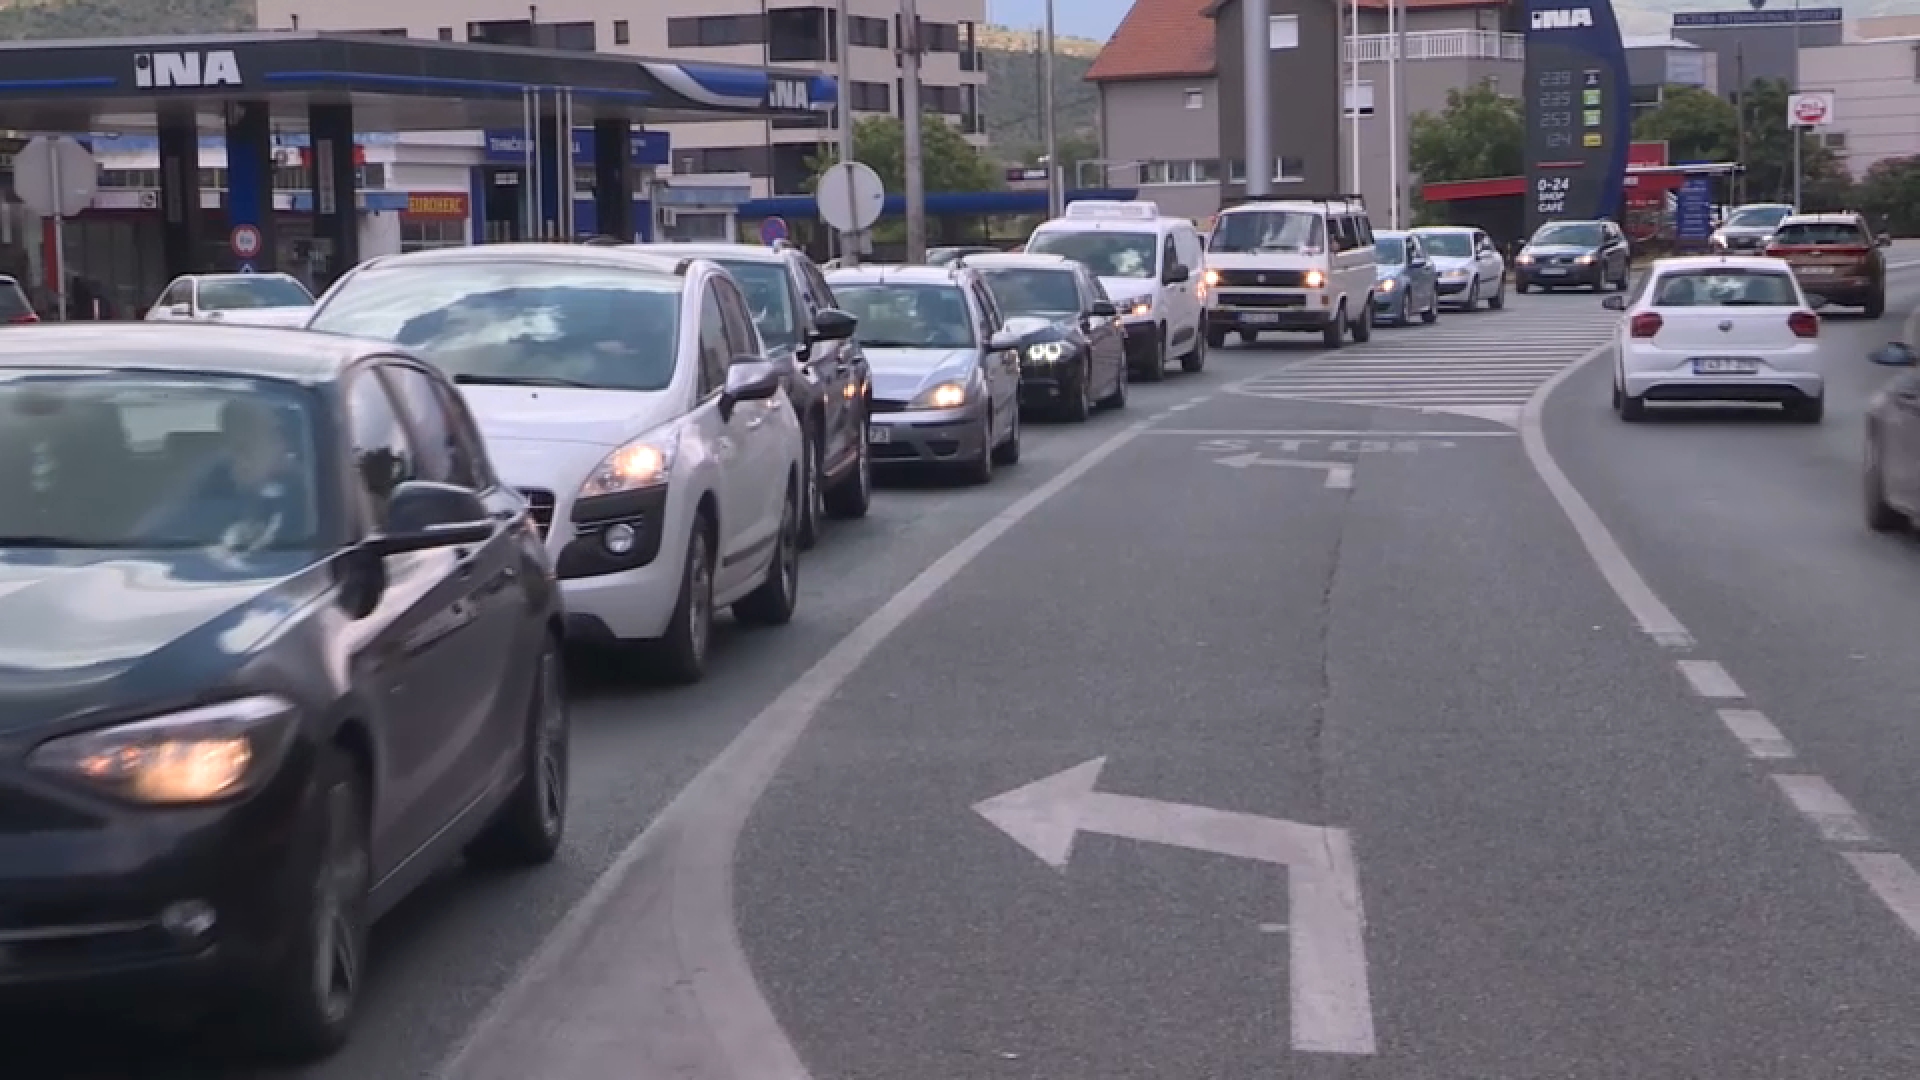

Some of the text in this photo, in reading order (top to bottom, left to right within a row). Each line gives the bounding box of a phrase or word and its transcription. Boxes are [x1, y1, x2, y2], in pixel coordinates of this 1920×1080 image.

[1537, 178, 1569, 191] 0-24
[1539, 191, 1565, 201] SHOP
[1196, 439, 1457, 453] STOP
